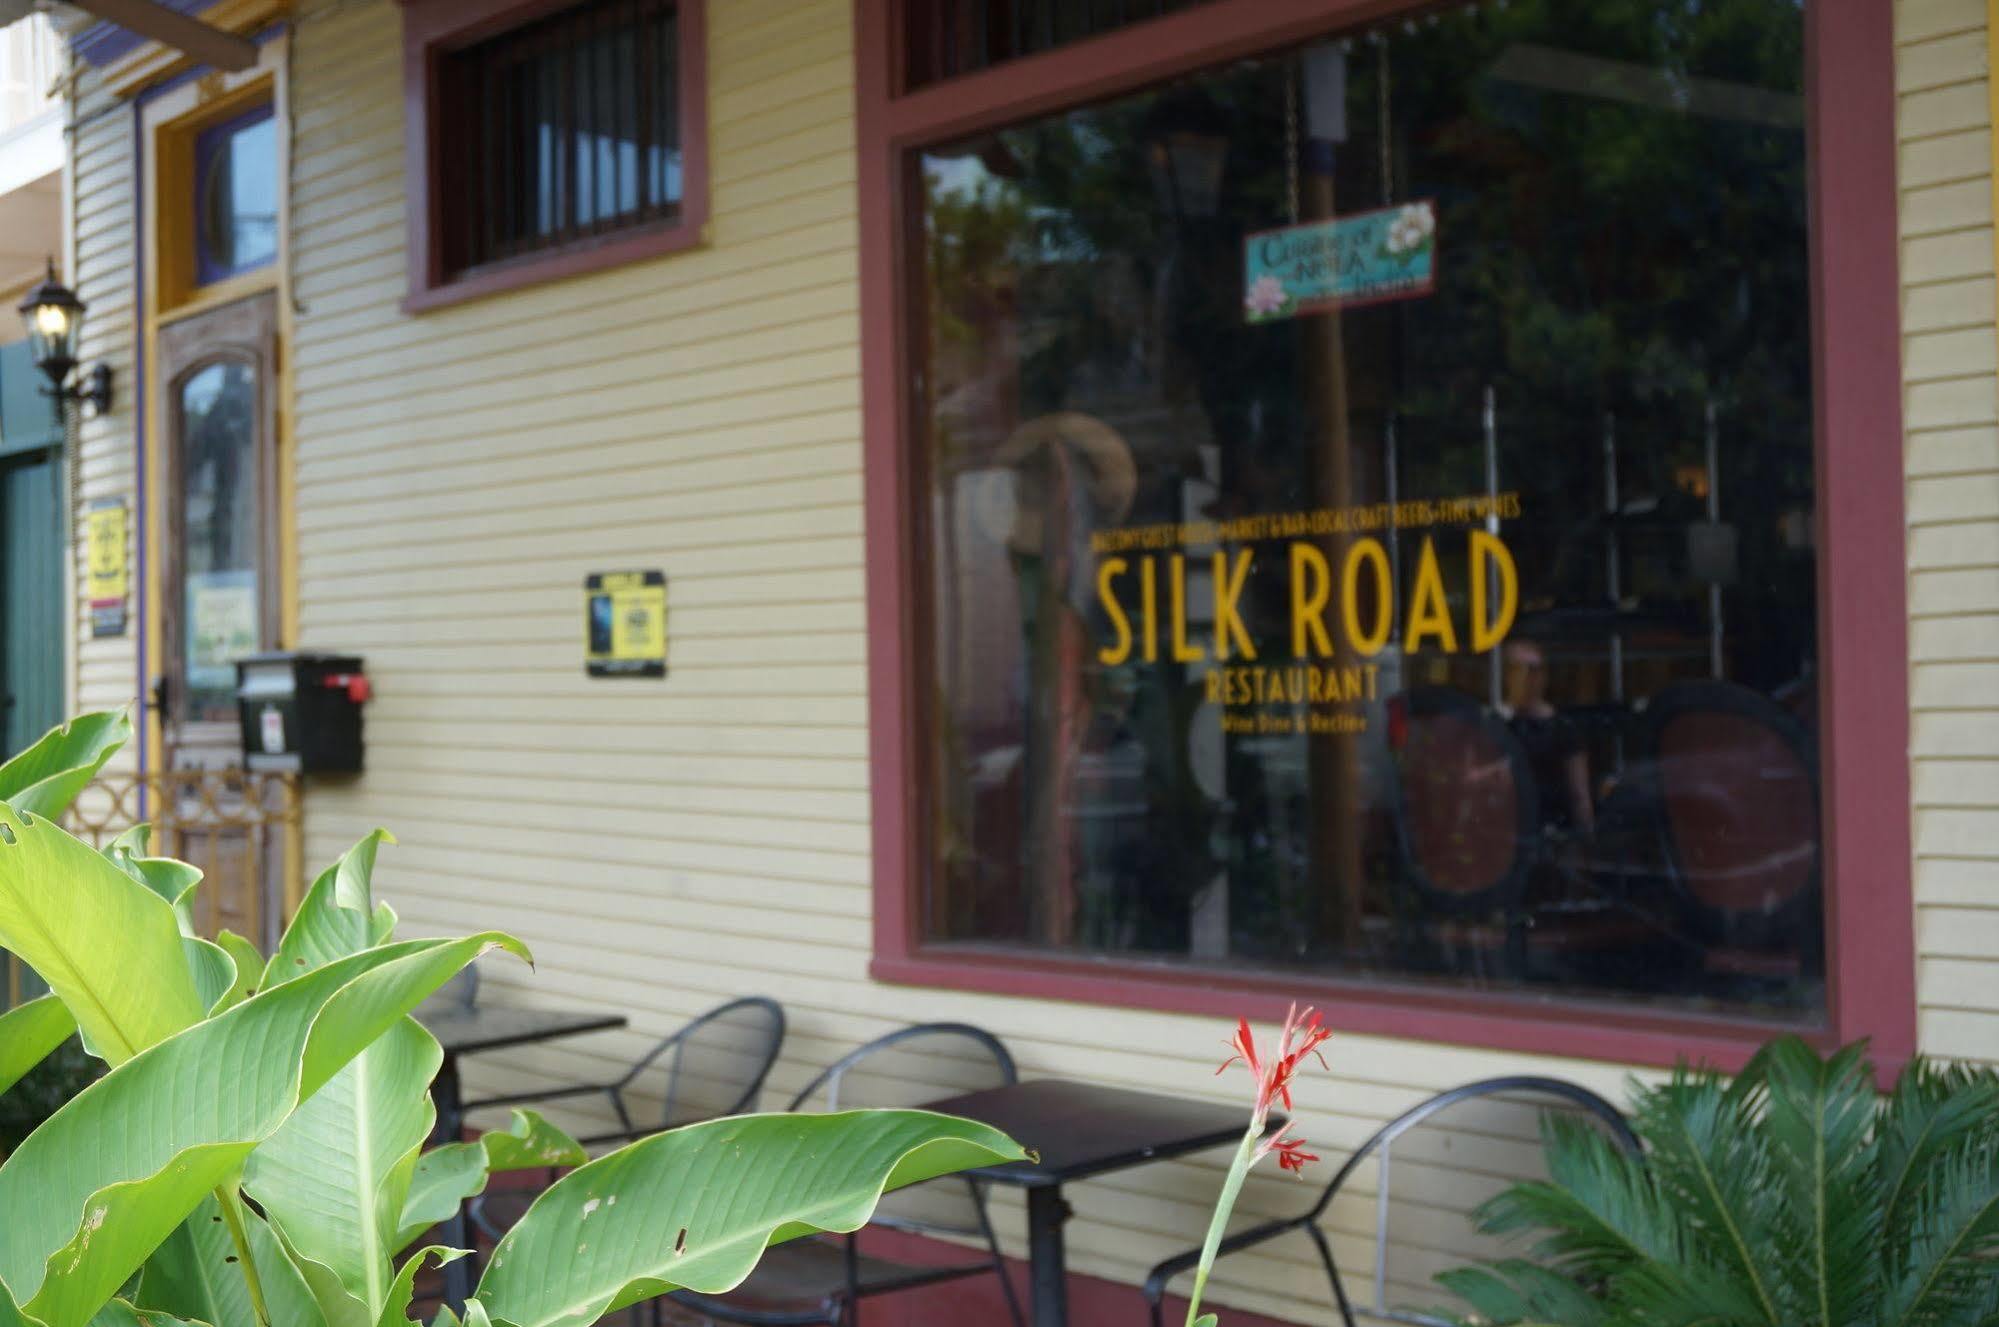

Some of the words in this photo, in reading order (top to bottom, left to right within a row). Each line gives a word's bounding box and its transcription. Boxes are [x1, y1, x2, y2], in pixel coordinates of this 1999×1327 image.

[1096, 547, 1257, 666] SILK
[1288, 529, 1520, 660] ROAD
[1205, 664, 1378, 706] RESTAURANT
